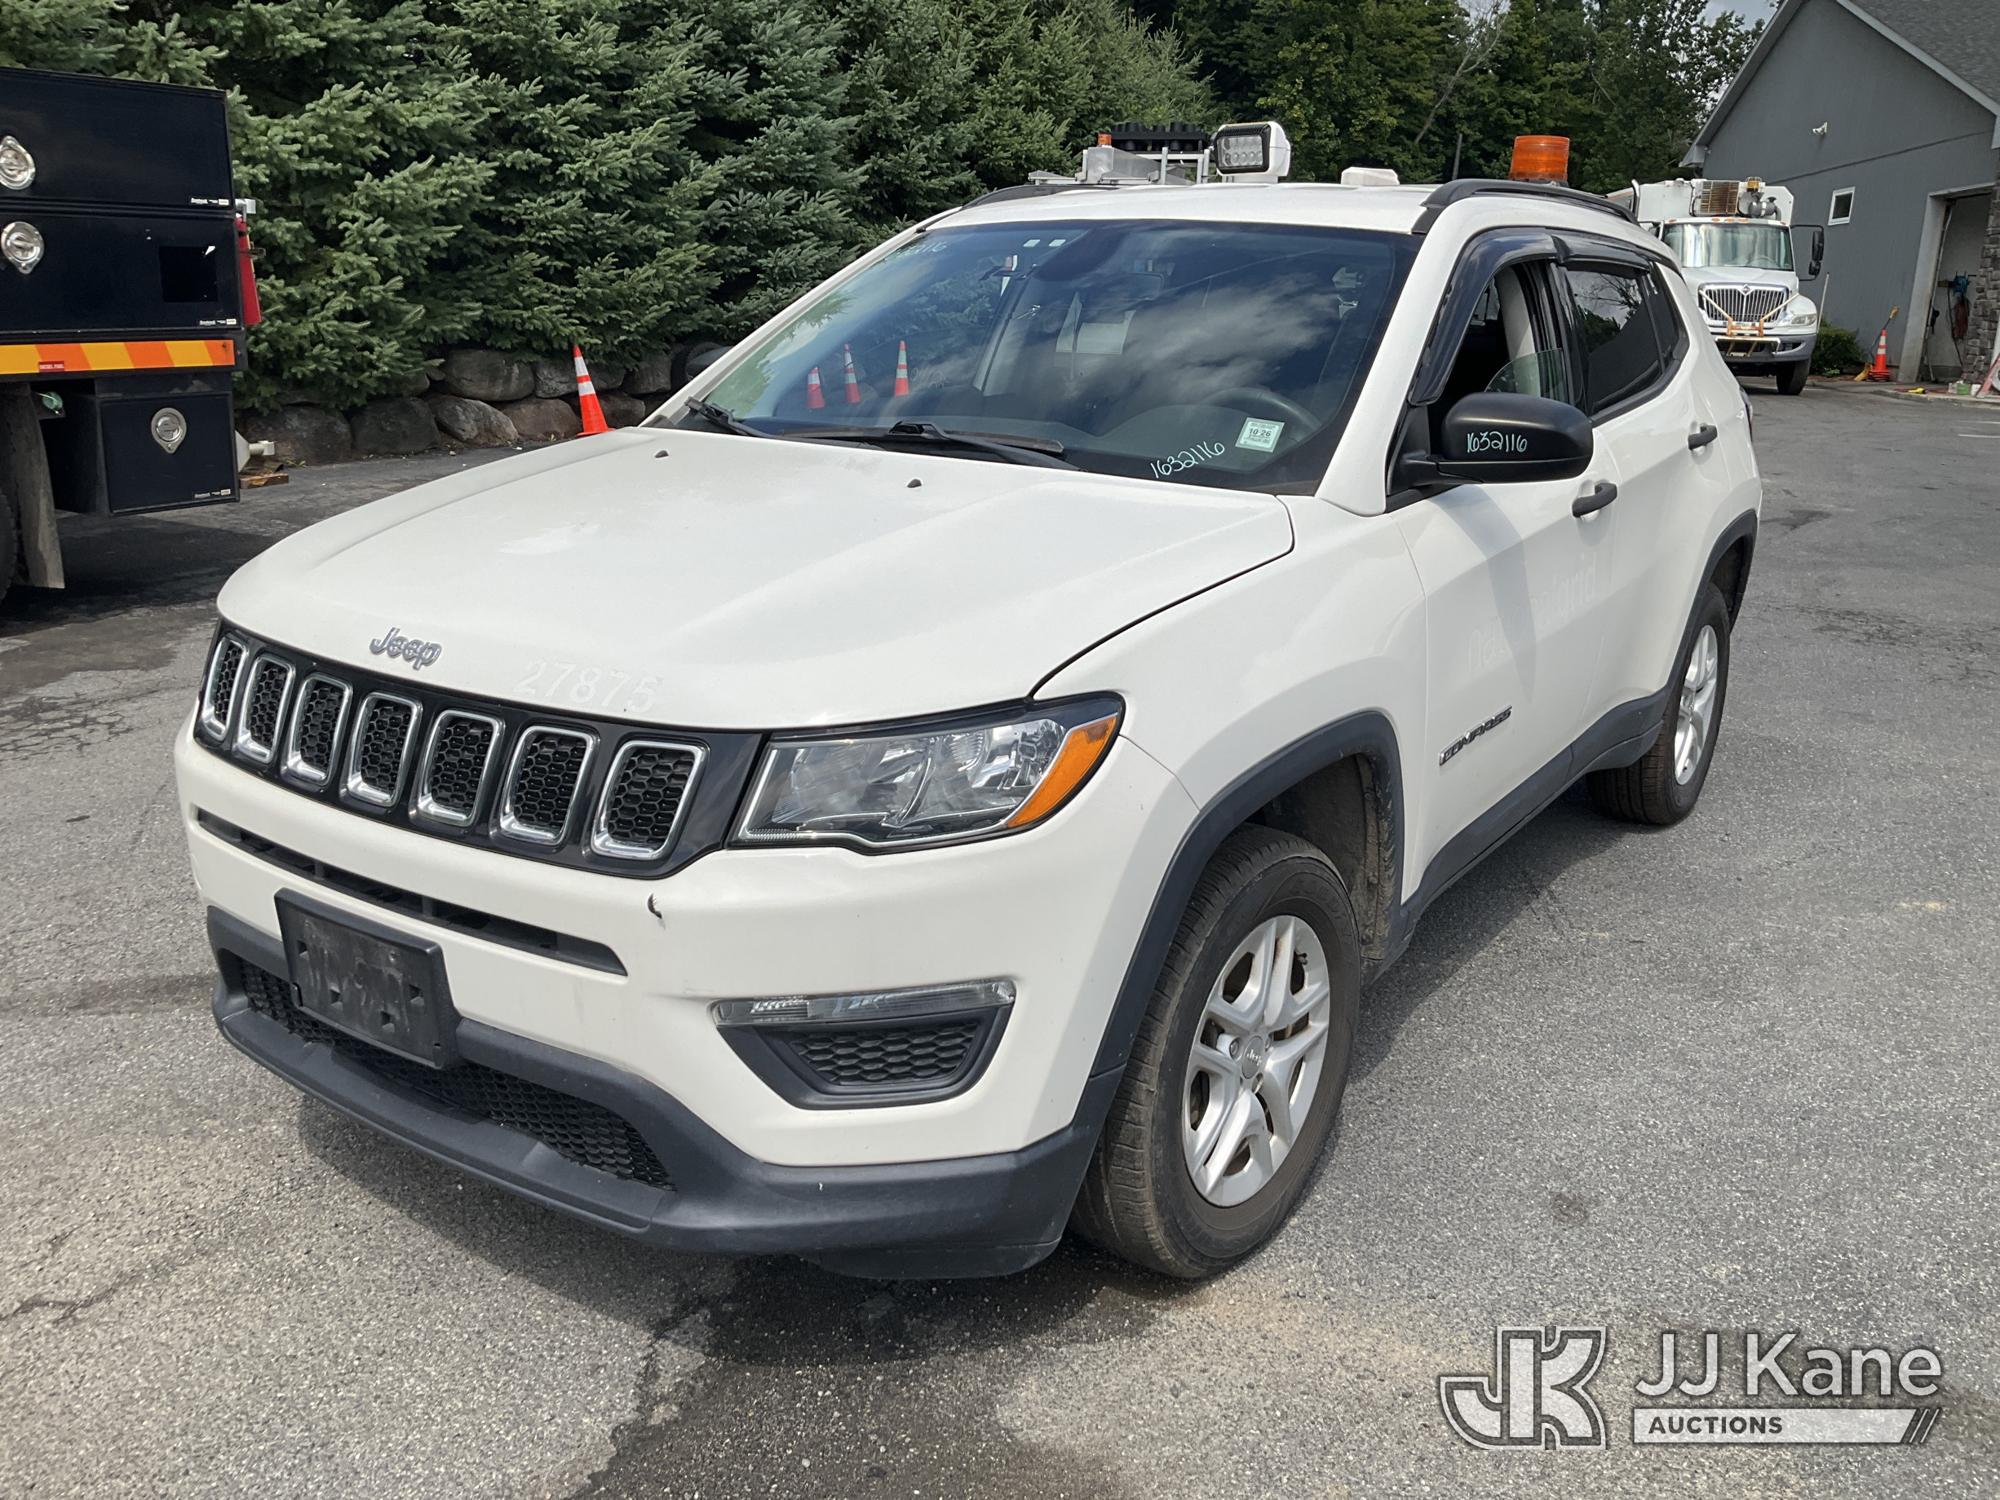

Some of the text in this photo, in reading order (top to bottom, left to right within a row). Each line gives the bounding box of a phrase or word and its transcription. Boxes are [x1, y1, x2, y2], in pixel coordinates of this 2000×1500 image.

[1150, 440, 1225, 479] 1632116
[1467, 431, 1528, 454] 1632116
[369, 627, 442, 671] Jeep
